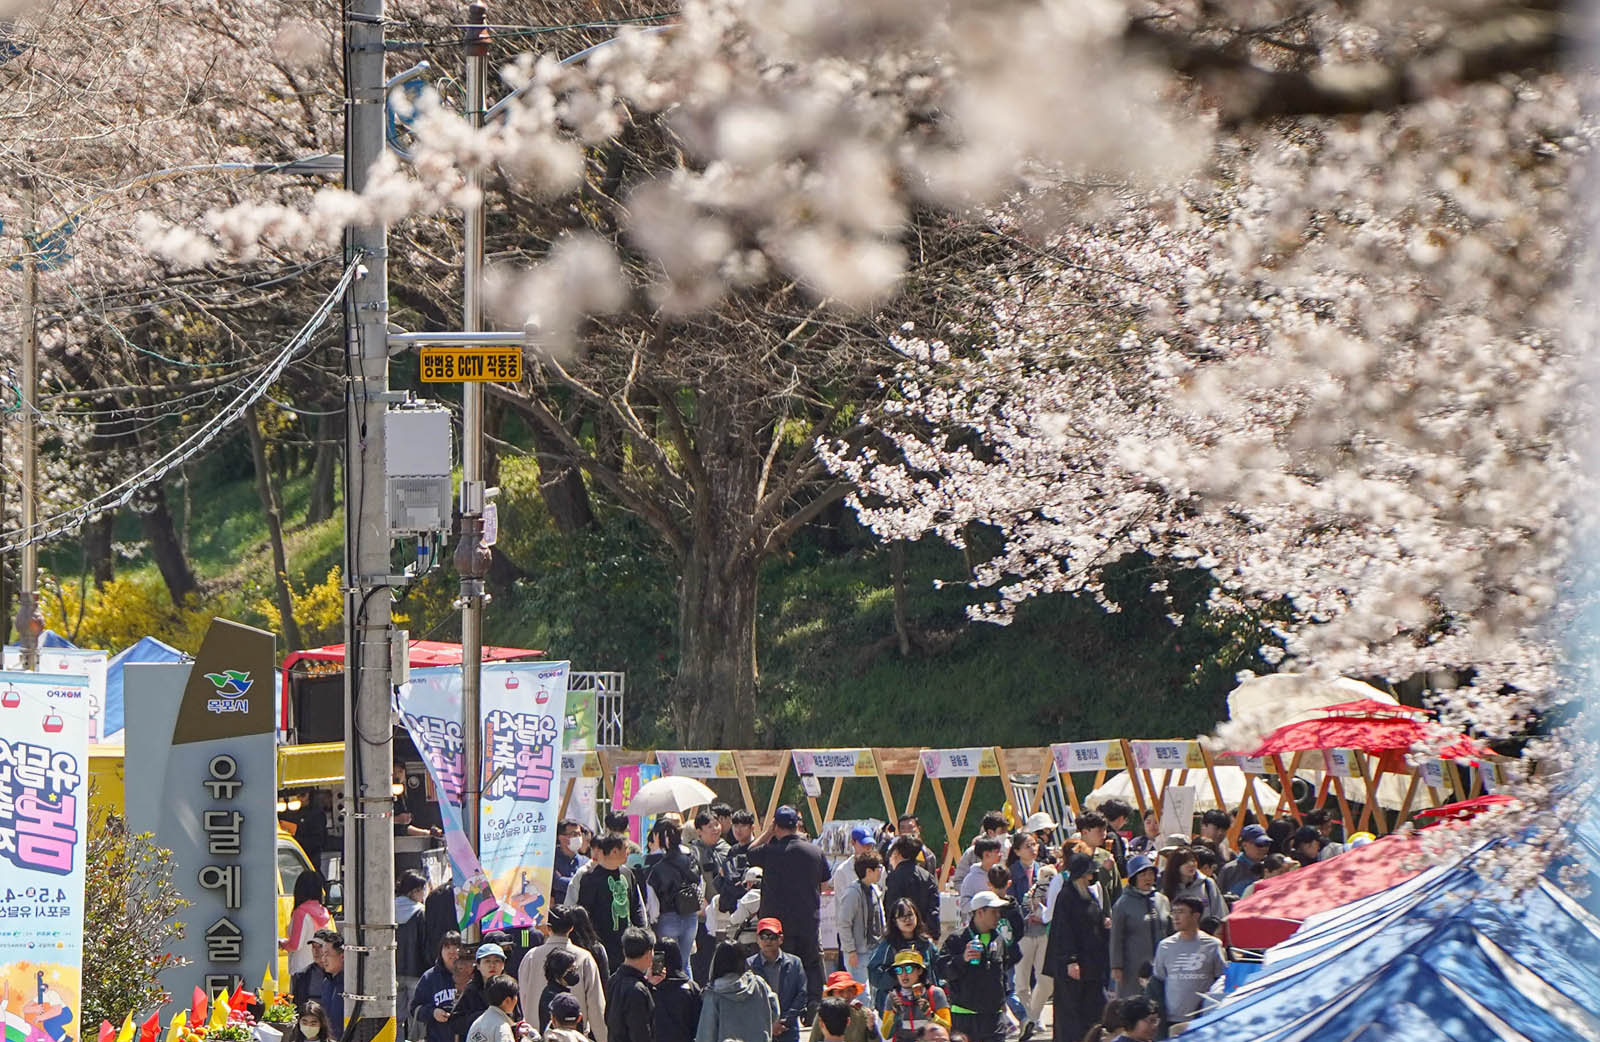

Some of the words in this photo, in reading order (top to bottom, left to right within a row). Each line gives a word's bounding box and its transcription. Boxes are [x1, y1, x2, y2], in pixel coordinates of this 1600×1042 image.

[424, 355, 454, 378] 방범용
[458, 355, 484, 377] CCTV
[487, 355, 518, 378] 작동중
[207, 699, 248, 714] 목포시
